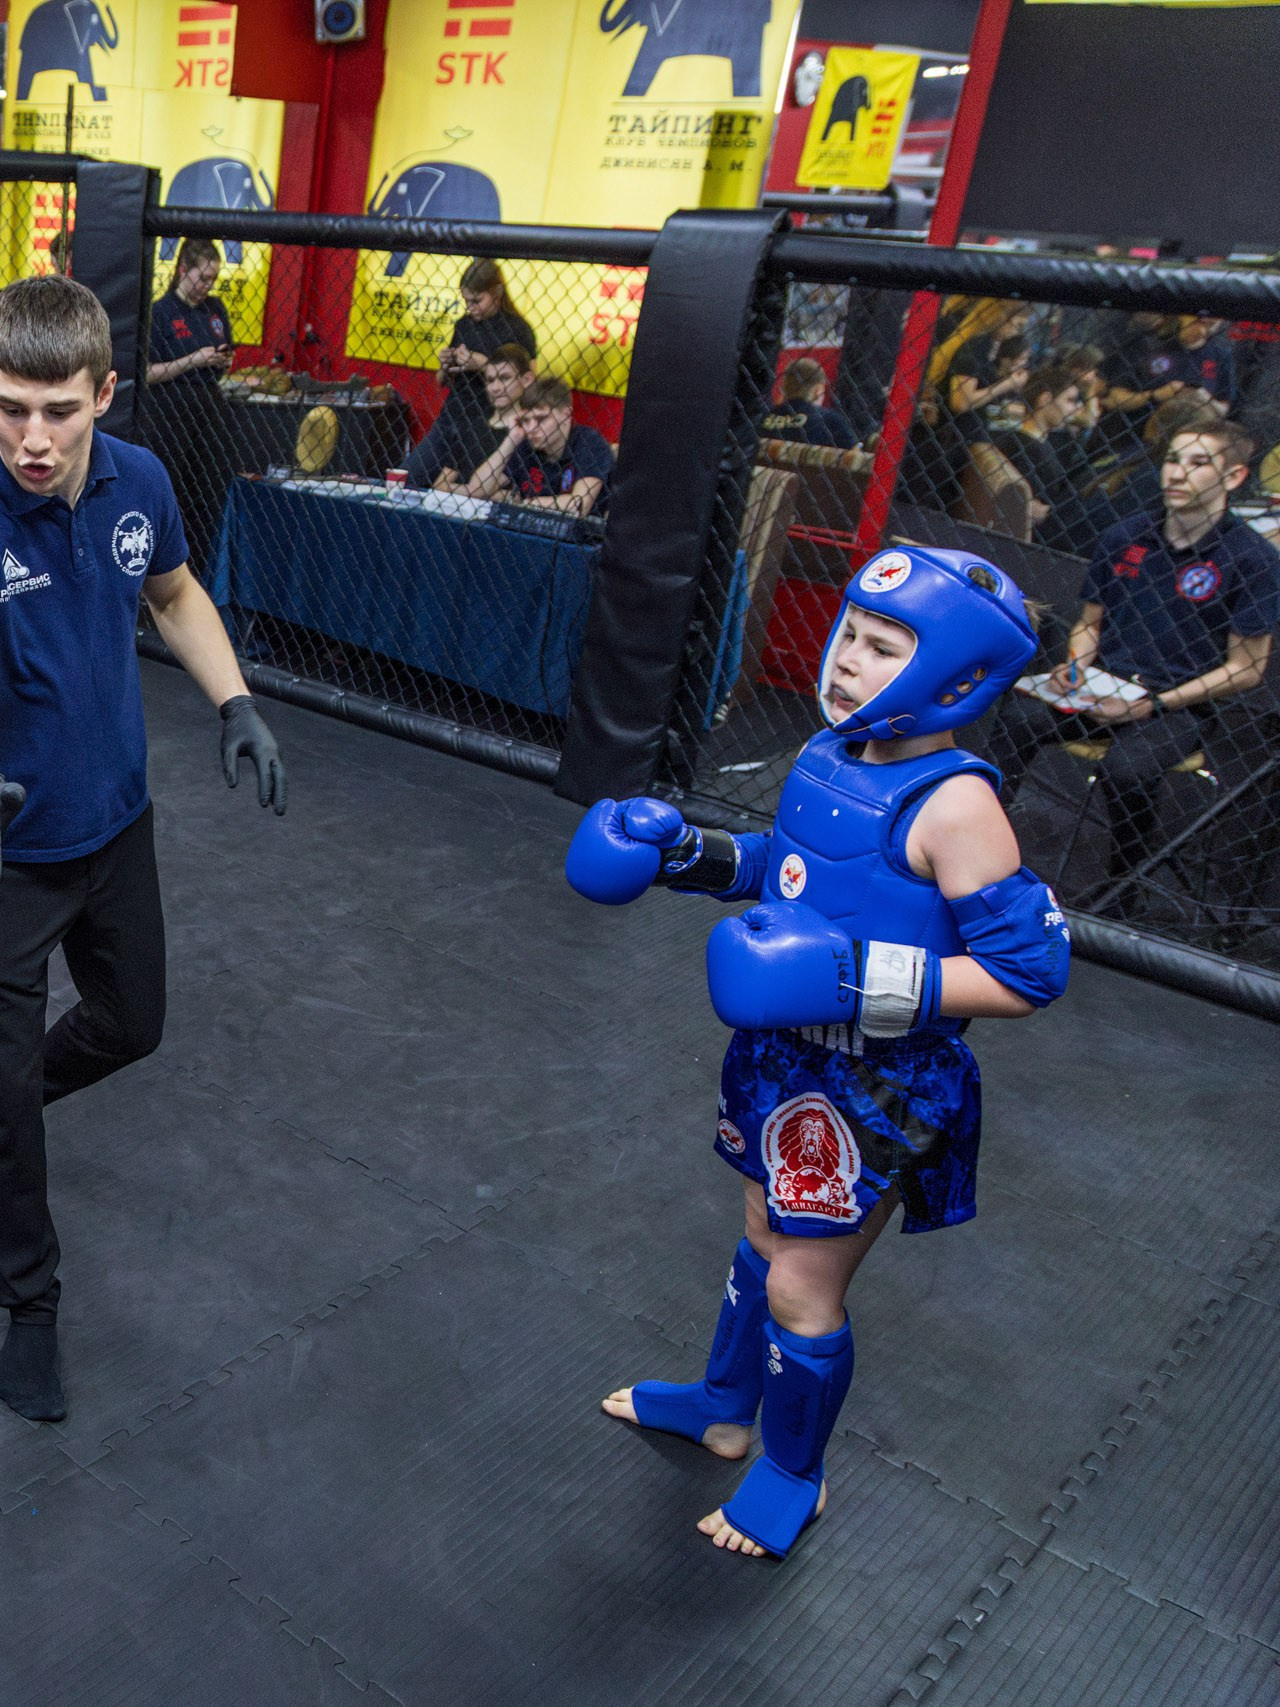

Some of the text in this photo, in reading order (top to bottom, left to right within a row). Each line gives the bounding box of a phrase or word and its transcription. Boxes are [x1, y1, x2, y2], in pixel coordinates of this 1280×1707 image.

[435, 51, 508, 85] STK
[609, 110, 762, 134] ТАЙПИНГ
[374, 289, 459, 315] ТАЙПИ
[590, 313, 638, 347] ST
